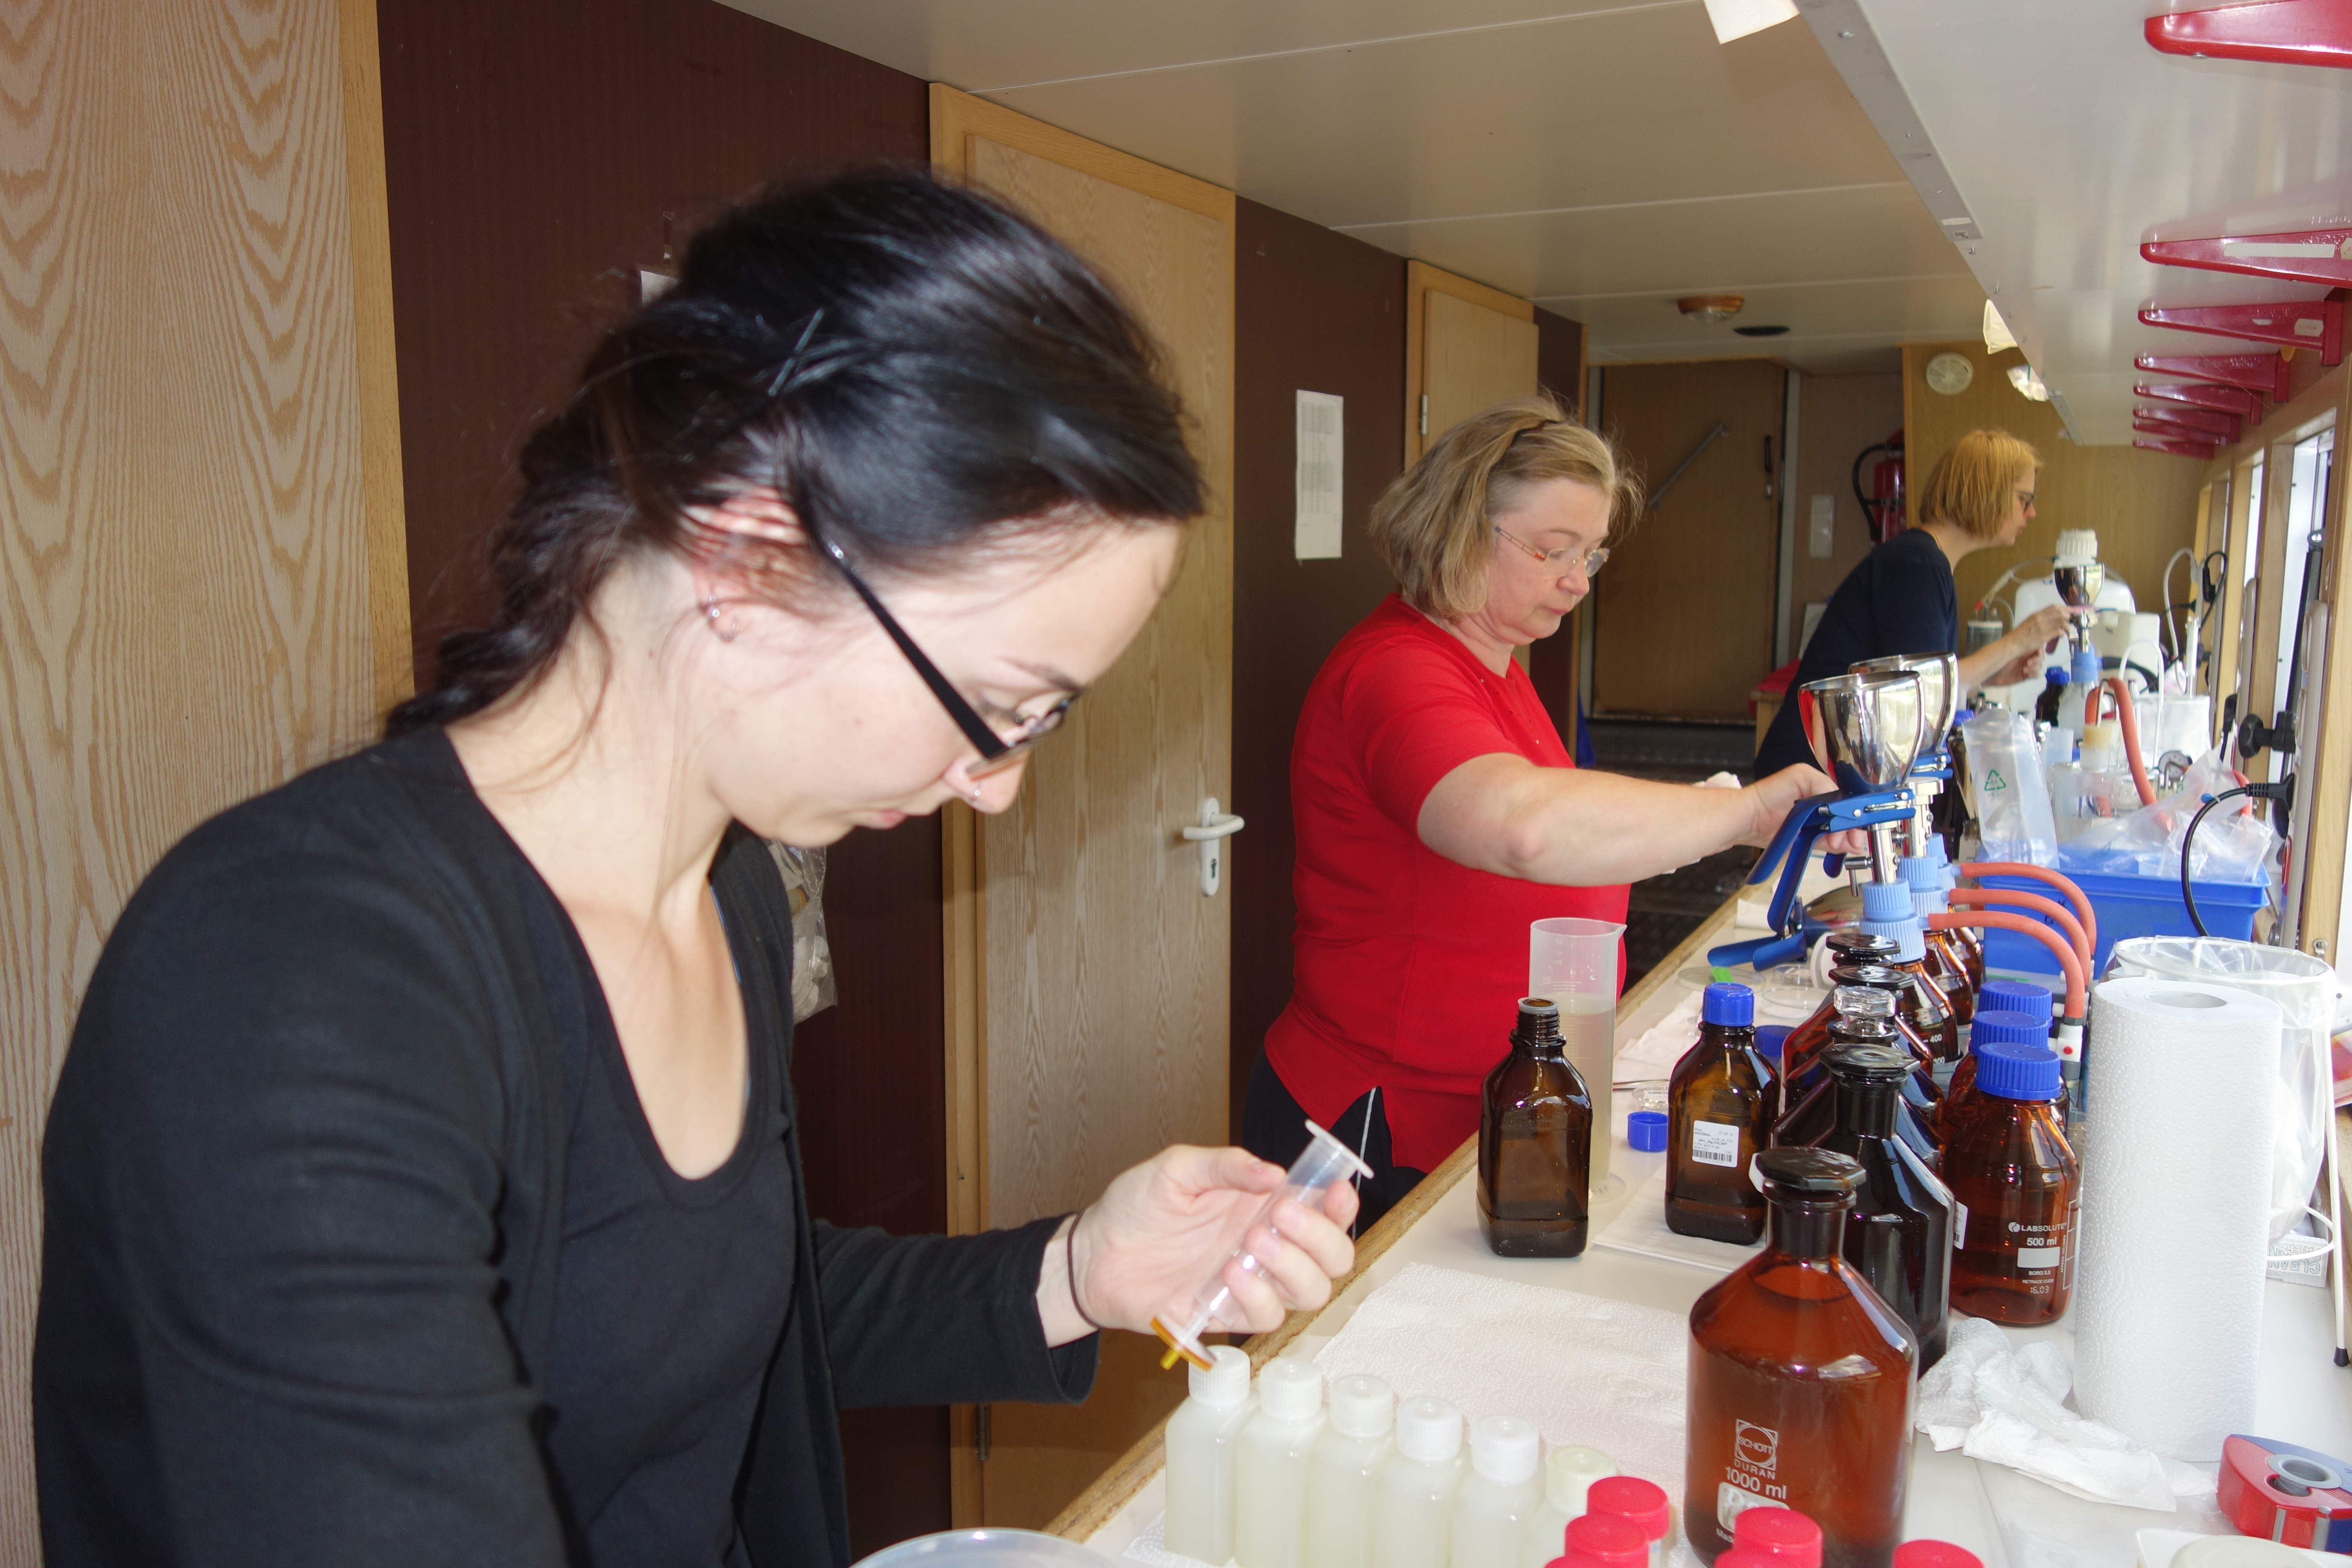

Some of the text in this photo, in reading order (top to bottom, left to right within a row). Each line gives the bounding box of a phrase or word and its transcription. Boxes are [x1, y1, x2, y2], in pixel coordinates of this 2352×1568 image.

[1930, 1033, 1942, 1043] 400
[1933, 1056, 1945, 1064] 300
[2027, 1236, 2057, 1246] 500 ml
[2268, 1246, 2321, 1274] CLEAN
[1738, 1436, 1773, 1455] SCHOTT
[1733, 1458, 1776, 1480] DURAN
[1724, 1466, 1787, 1500] 1000 ml
